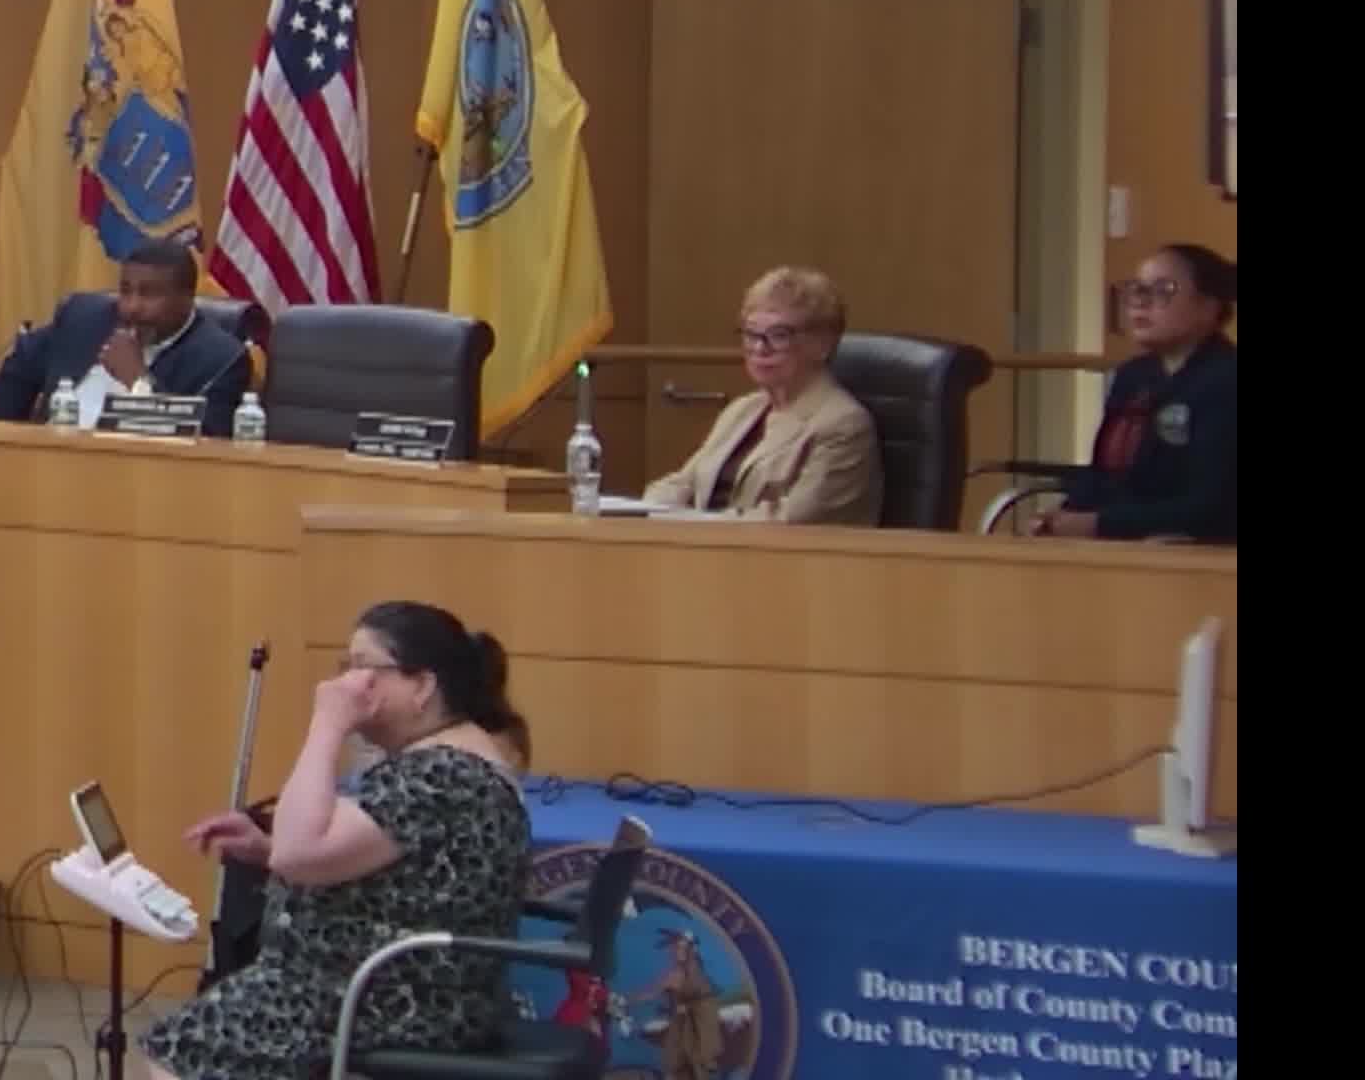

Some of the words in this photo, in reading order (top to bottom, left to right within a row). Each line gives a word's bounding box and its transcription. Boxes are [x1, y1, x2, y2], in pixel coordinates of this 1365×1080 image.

[959, 933, 1131, 979] BERGEN
[1138, 954, 1237, 993] COU
[858, 969, 964, 1007] Board
[974, 982, 1011, 1010] of
[1014, 985, 1141, 1033] County
[821, 1010, 892, 1045] One
[899, 1016, 1020, 1058] Bergen
[1026, 1031, 1157, 1077] County
